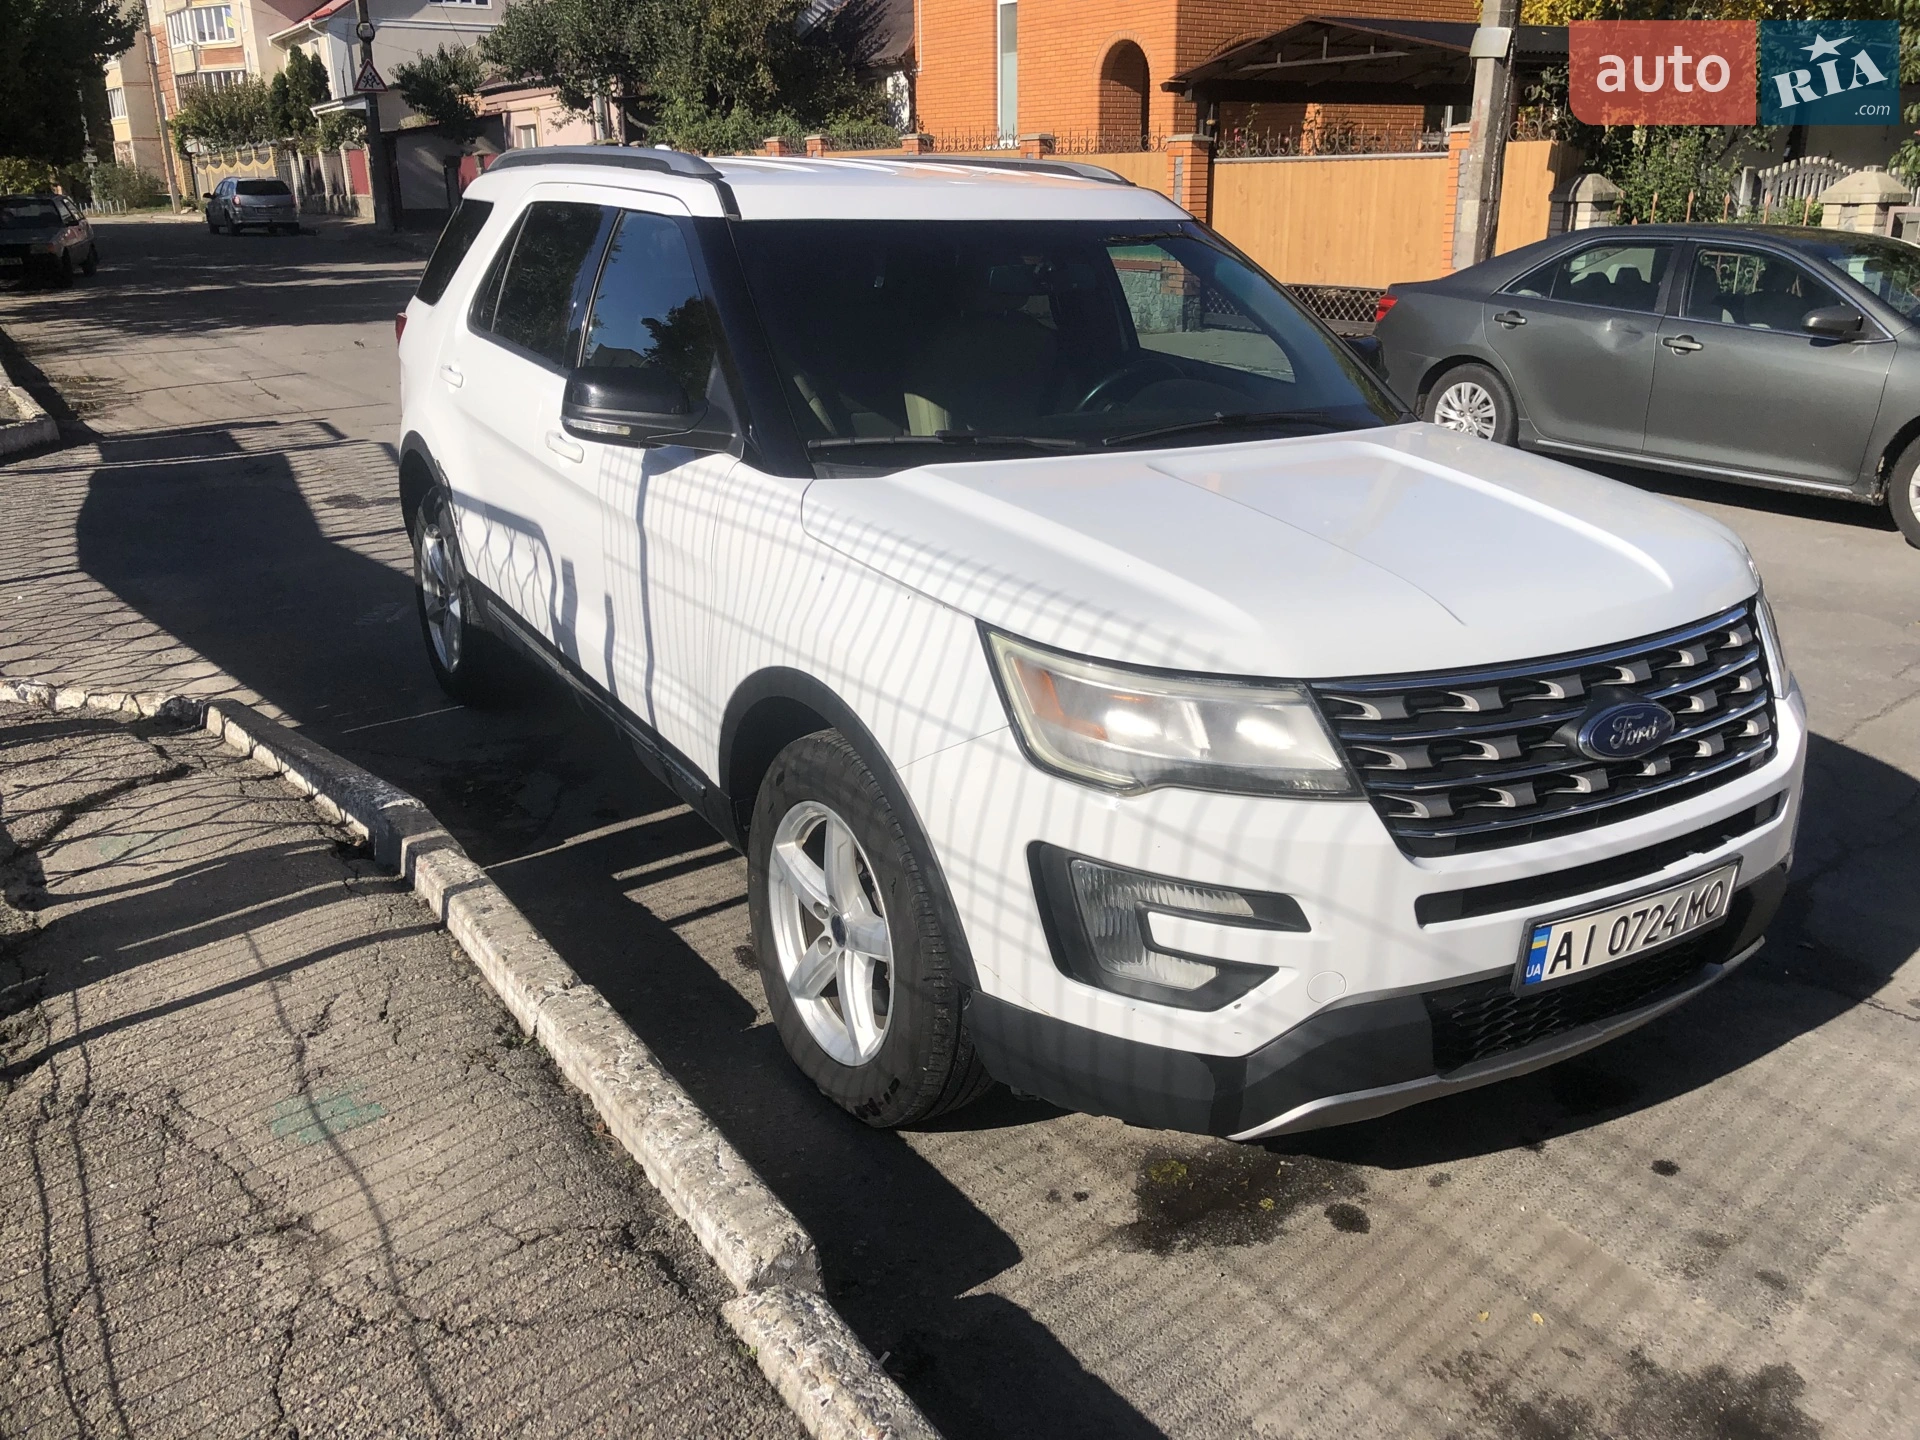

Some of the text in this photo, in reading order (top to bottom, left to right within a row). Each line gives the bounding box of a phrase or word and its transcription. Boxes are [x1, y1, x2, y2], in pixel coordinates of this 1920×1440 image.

[1610, 713, 1659, 749] Ford
[1547, 880, 1723, 974] AI 0724 MO
[1526, 963, 1541, 977] UA
